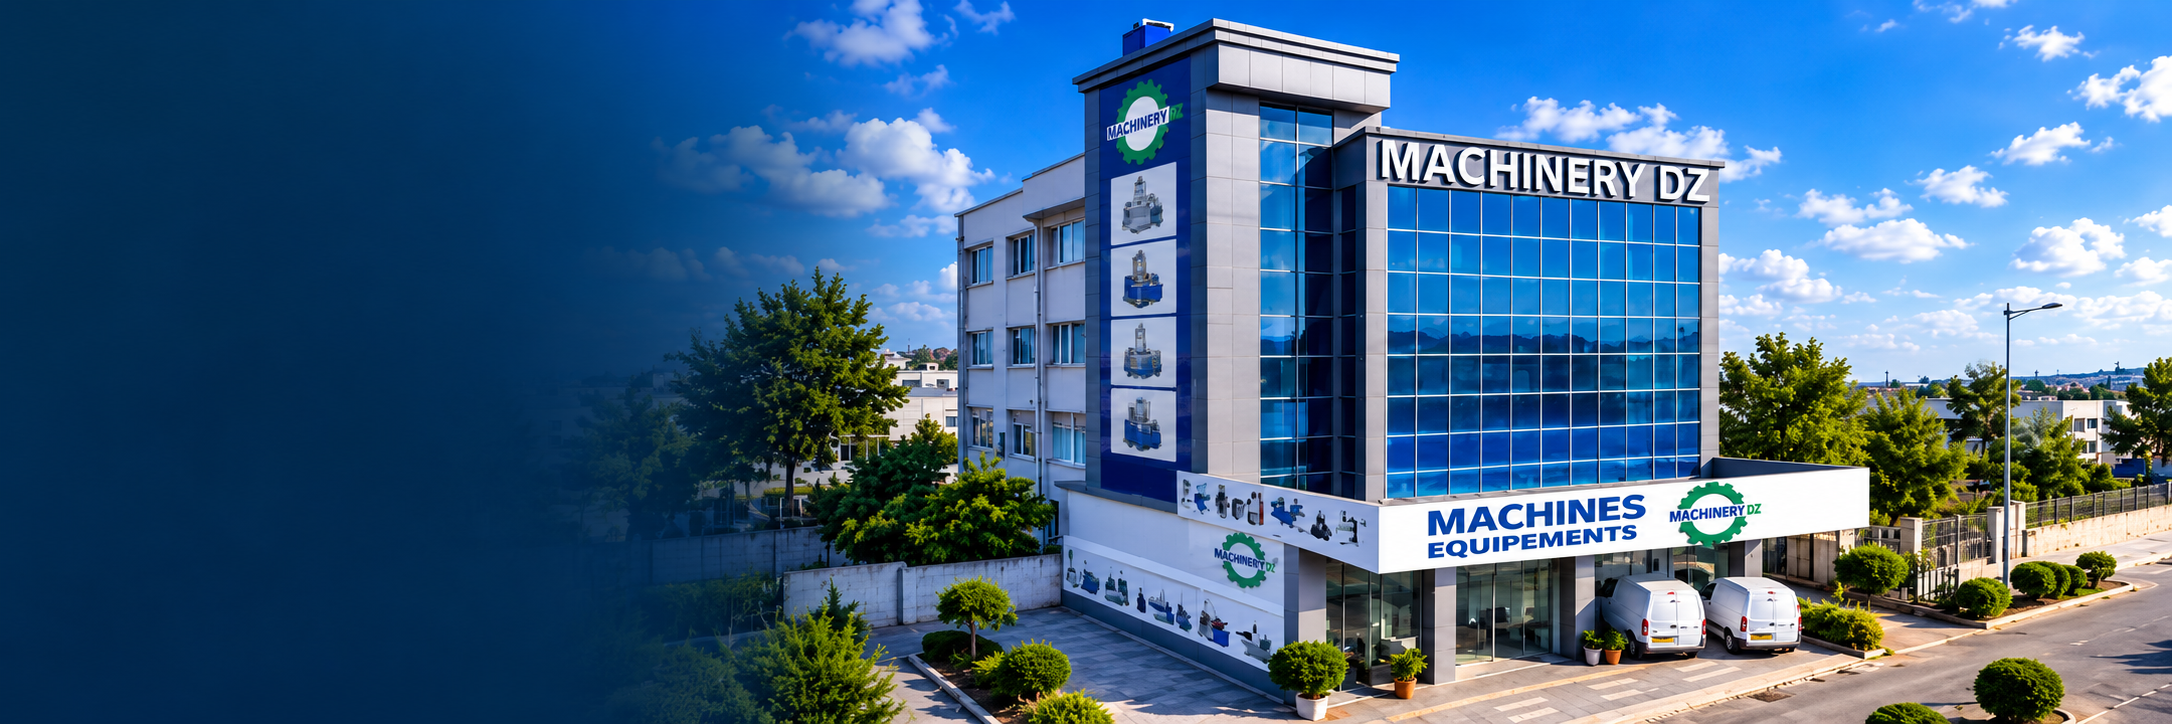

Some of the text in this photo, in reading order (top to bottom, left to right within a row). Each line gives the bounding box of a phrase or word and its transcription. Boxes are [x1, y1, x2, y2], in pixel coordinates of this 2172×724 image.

[1108, 109, 1167, 140] MACHINERY
[1381, 139, 1711, 202] MACHINERY DZ
[1427, 494, 1647, 537] MACHINES
[1669, 503, 1762, 523] MACHINERY DZ
[1427, 524, 1638, 559] EQUIPEMENTS
[1214, 548, 1265, 570] MACHINERY
